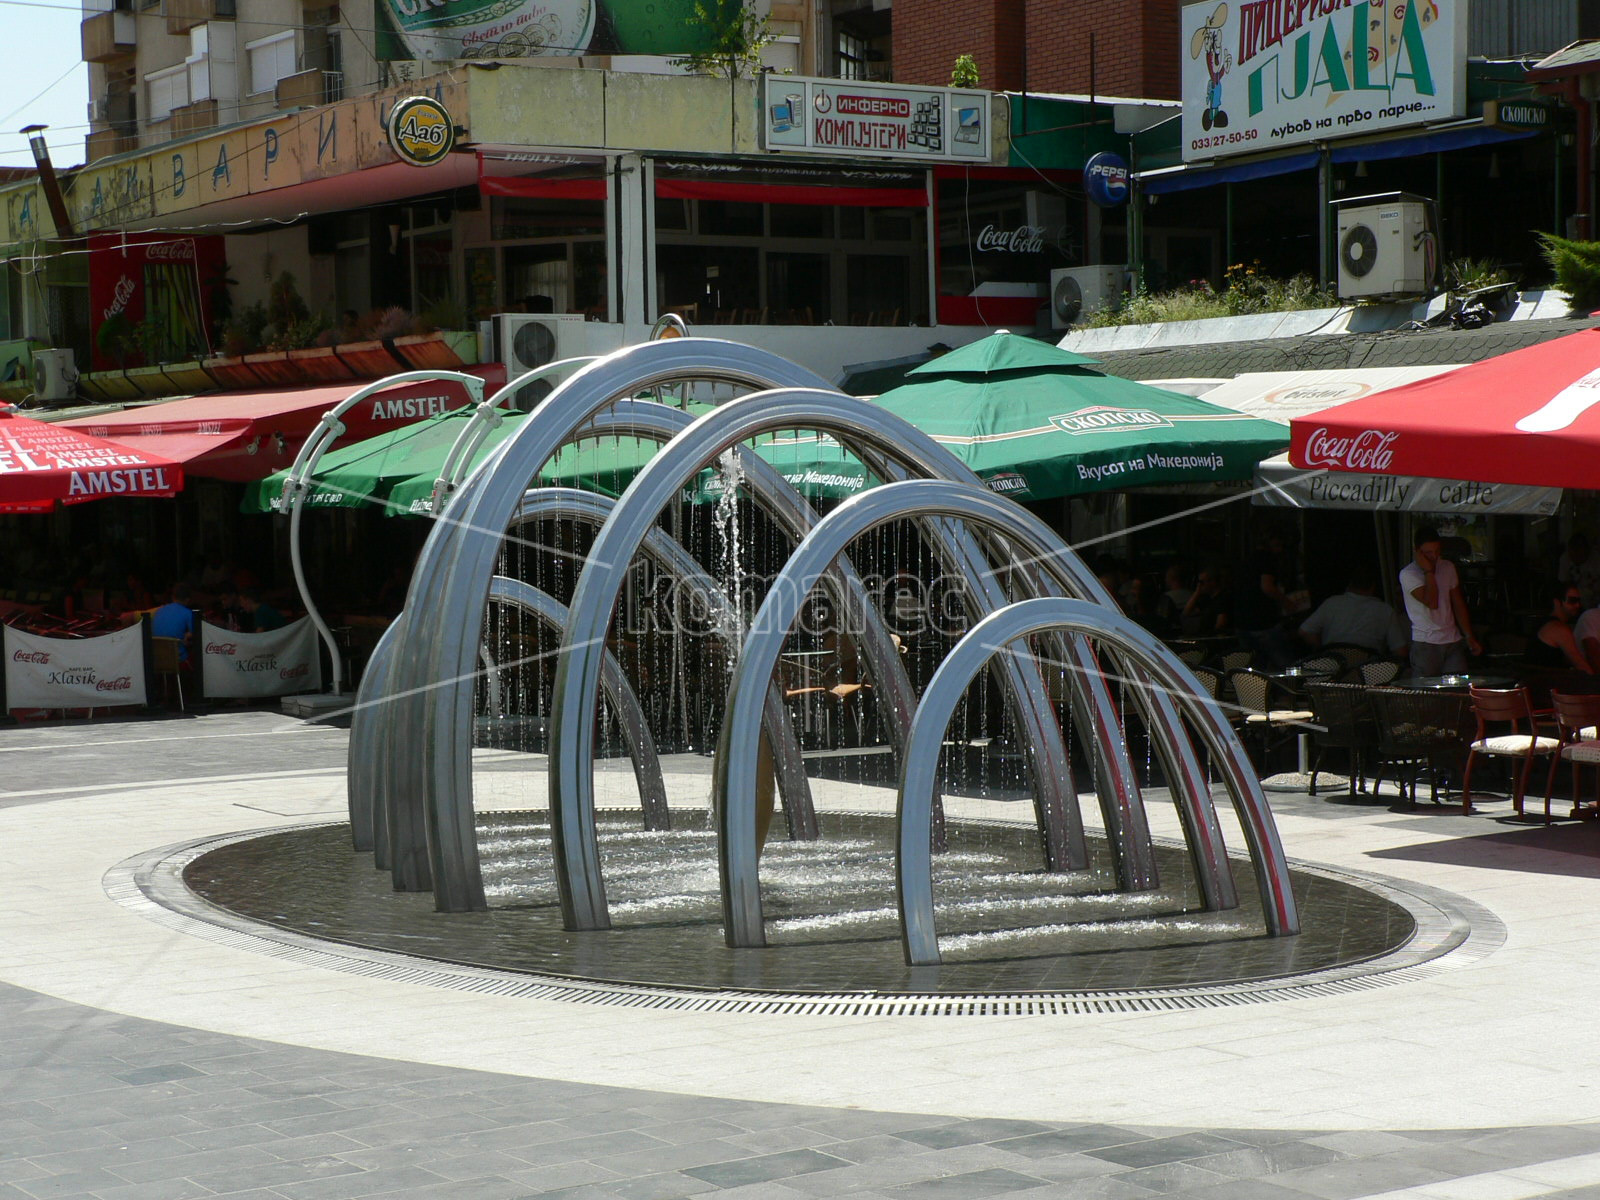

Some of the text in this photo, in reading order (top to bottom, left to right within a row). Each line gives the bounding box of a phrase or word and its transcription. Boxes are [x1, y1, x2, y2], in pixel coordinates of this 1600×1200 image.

[1248, 0, 1435, 118] ПЈАЦА
[838, 98, 909, 115] ИНФЕРНО
[1502, 105, 1546, 124] СКОПСКО
[1316, 118, 1332, 129] на
[1337, 109, 1372, 126] прво
[398, 116, 447, 145] Даб
[815, 118, 907, 150] КОМПЈУТЕРИ
[1191, 129, 1258, 151] 033/27-50-50
[1090, 165, 1128, 180] PEPSI
[976, 224, 1047, 253] Coca-Cola
[371, 396, 450, 420] AMSTEL
[1060, 409, 1162, 431] СКОПСКО
[27, 436, 79, 444] AMSTEL
[35, 442, 95, 452] AMSTEL
[1304, 427, 1400, 470] Coca-Cola
[45, 448, 120, 460] AMSTEL
[57, 455, 147, 470] AMSTEL
[1076, 451, 1225, 482] Вкусот на Македонија
[68, 467, 170, 496] AMSTEL
[803, 470, 865, 492] Македонија
[1309, 475, 1410, 509] Piccadilly
[13, 649, 51, 665] Coca-Cola
[235, 658, 278, 672] Klasik
[48, 671, 97, 685] Klasik
[96, 676, 132, 692] Coca-Cola
